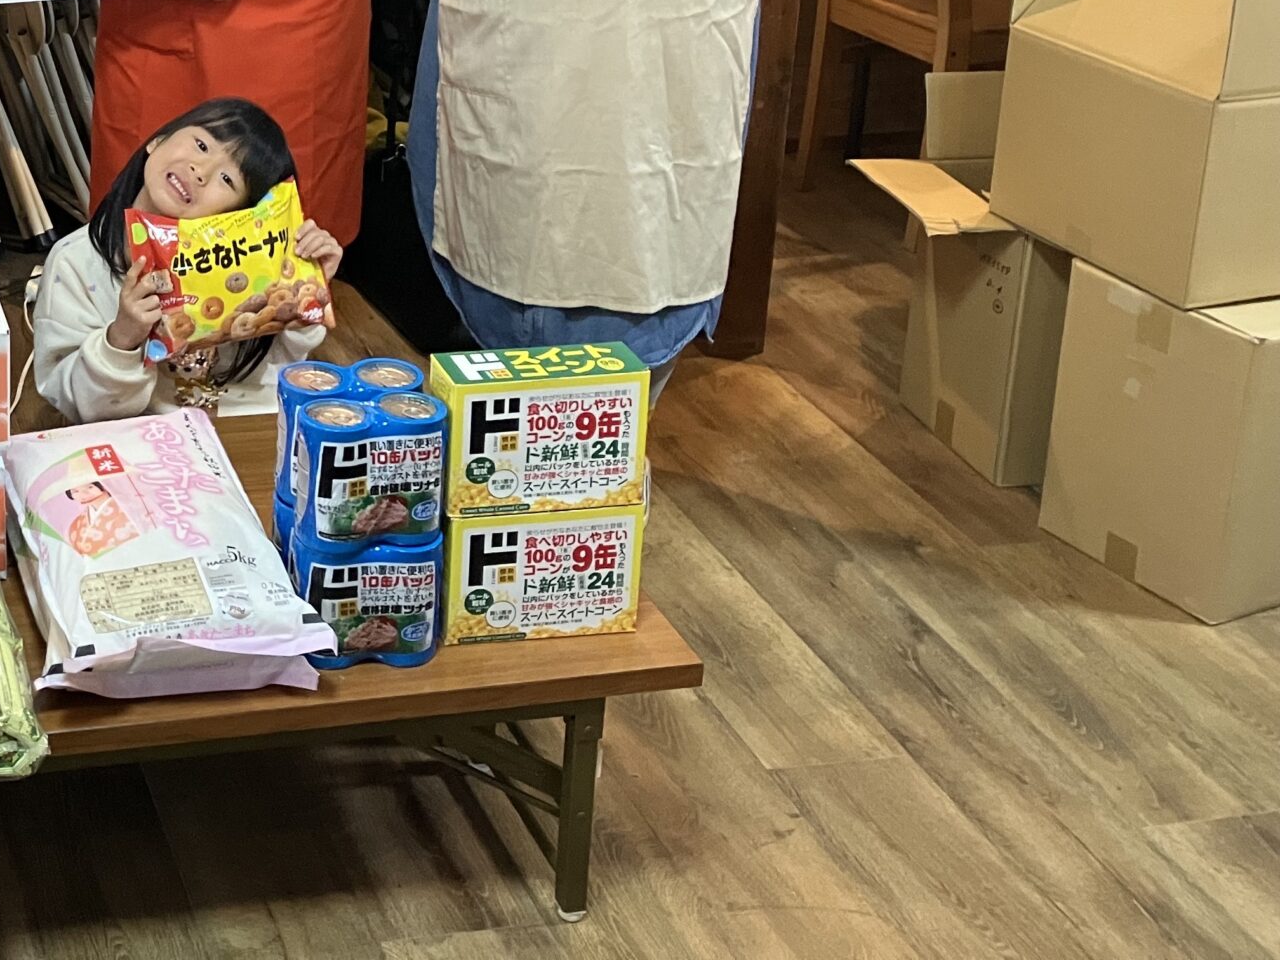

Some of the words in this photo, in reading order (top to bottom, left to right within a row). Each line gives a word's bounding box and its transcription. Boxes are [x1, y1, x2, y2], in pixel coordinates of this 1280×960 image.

[173, 228, 289, 276] 小さなドーナツ
[504, 345, 611, 366] スイート
[515, 360, 595, 377] コーン
[527, 397, 632, 416] 食べ切りしやすい
[469, 398, 520, 454] ド
[526, 431, 574, 444] コーンが
[526, 443, 579, 463] ド新鮮
[591, 440, 620, 458] 24
[91, 448, 120, 472] 新米
[524, 460, 628, 472] 以内にパックをしているから
[318, 443, 367, 498] ド
[523, 476, 628, 492] スーパースイートコーン
[525, 530, 627, 549] 食べ切りしやすい
[227, 545, 257, 567] 5kg
[468, 531, 518, 586] ド
[524, 564, 570, 576] コーンが
[360, 574, 434, 588] 10缶パック
[524, 575, 575, 595] ド新鮮
[588, 571, 615, 590] 24
[522, 590, 623, 603] 以内にパックをしているから
[521, 605, 623, 622] スーパースイートコーン
